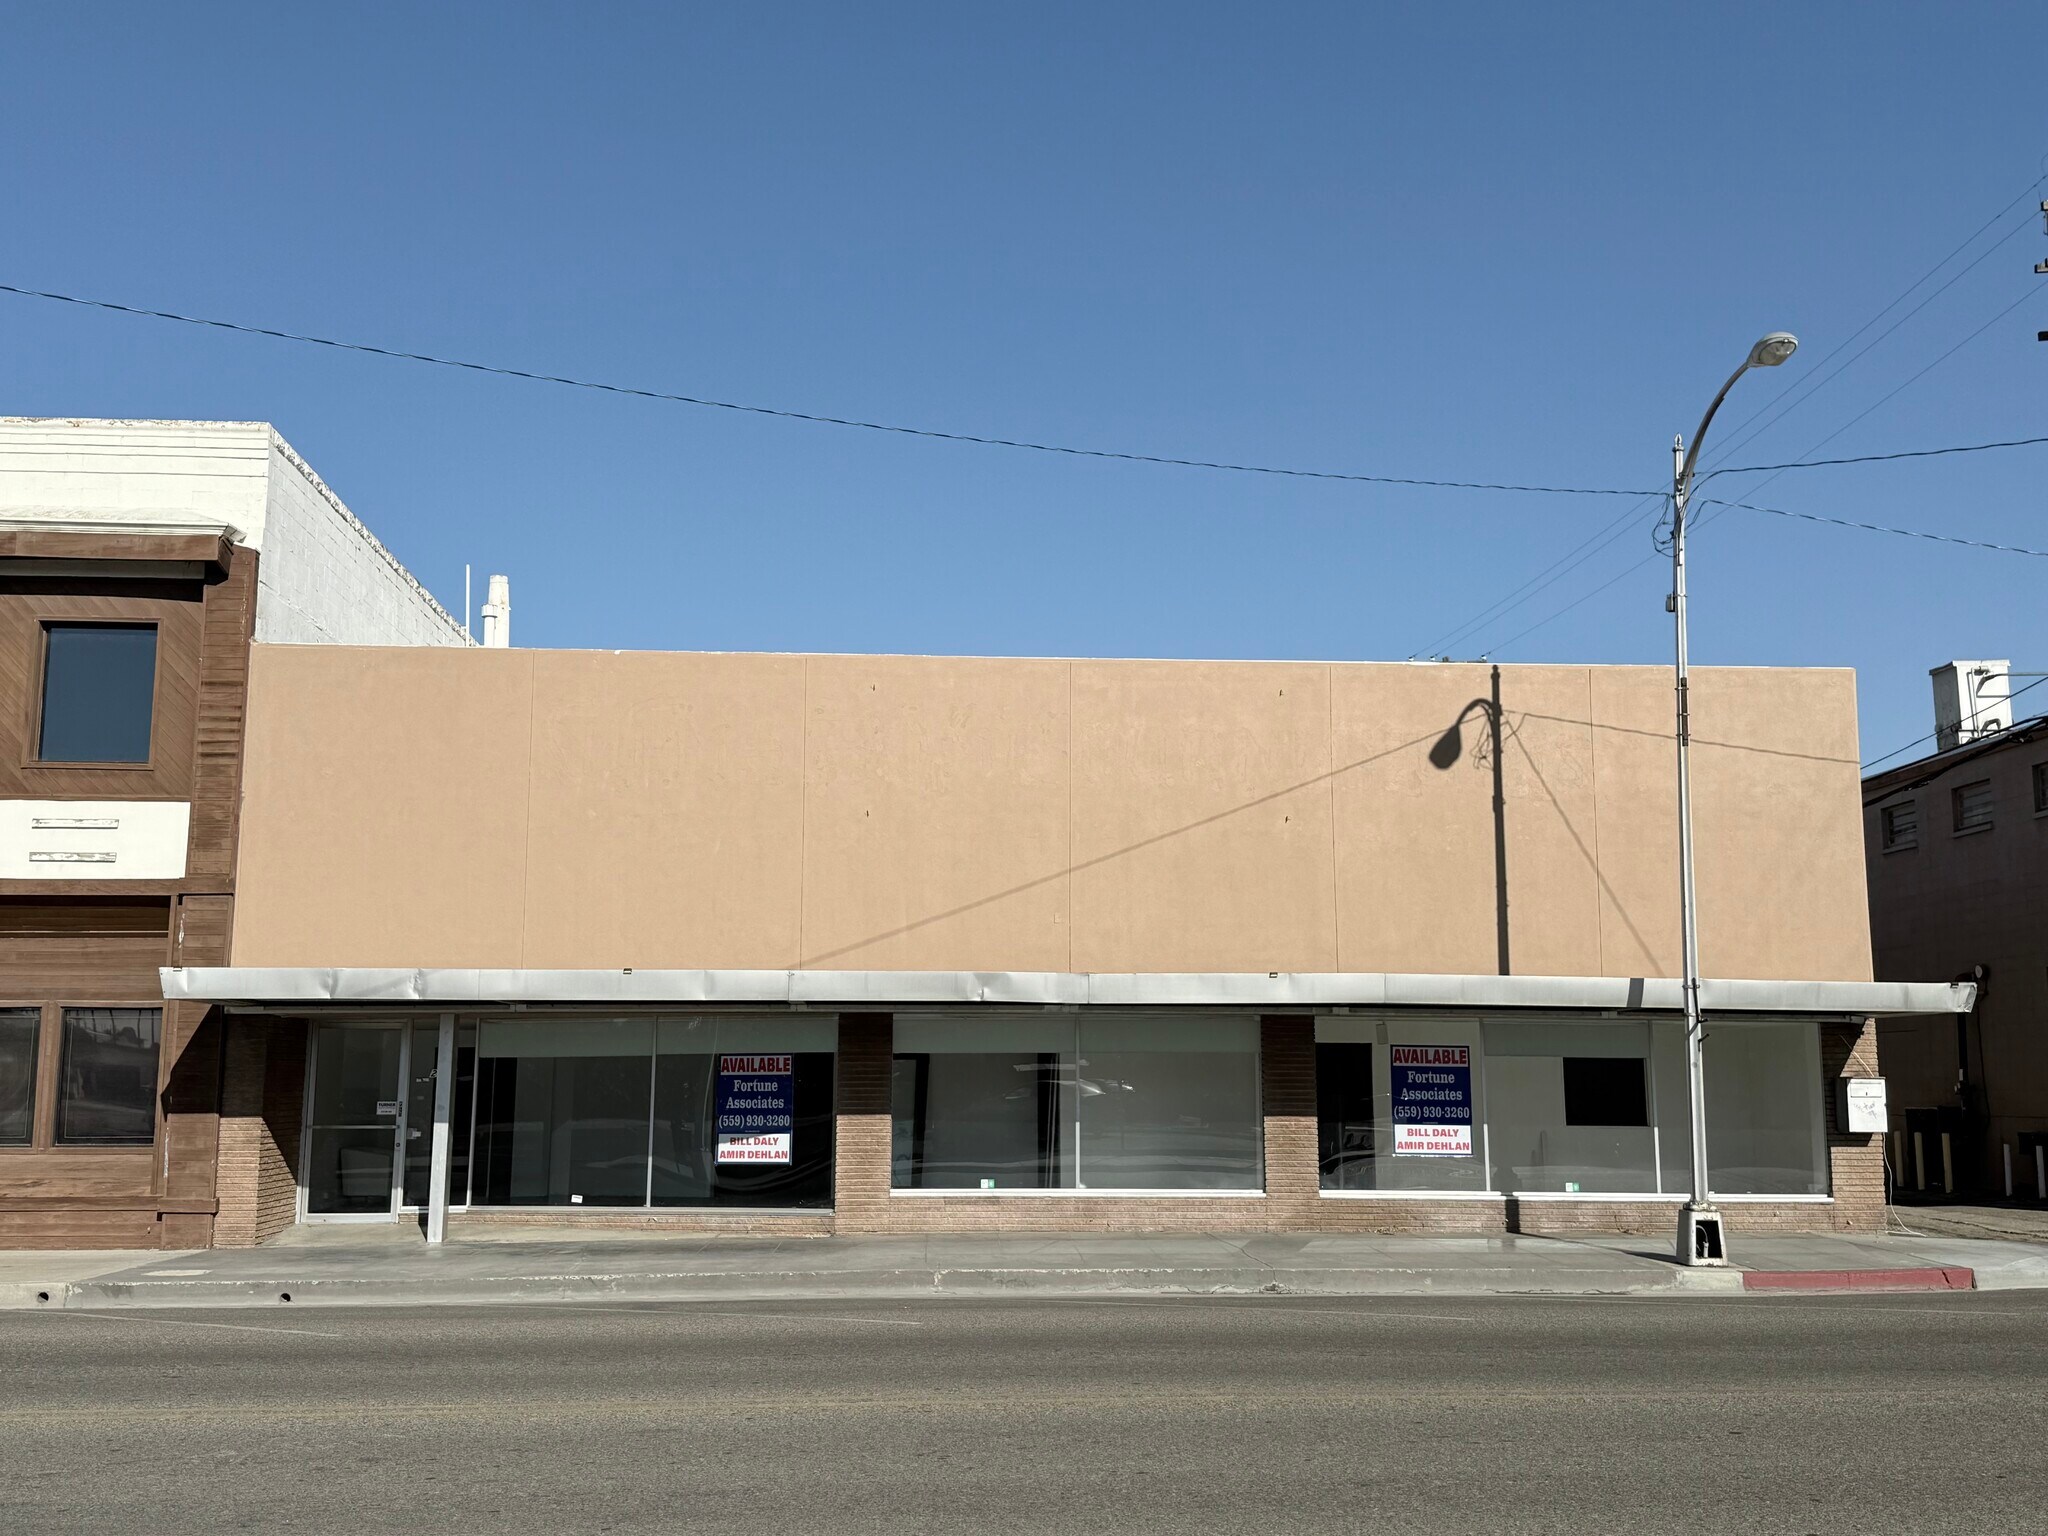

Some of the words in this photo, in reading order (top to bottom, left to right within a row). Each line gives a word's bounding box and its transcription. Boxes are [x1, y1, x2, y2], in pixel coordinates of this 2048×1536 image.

[1394, 1048, 1467, 1064] AVAILABLE
[721, 1057, 791, 1073] AVAILABLE
[1407, 1070, 1455, 1083] Fortune
[733, 1079, 778, 1092] Fortune
[1400, 1087, 1463, 1101] Associates
[726, 1095, 784, 1109] Associates
[1394, 1105, 1421, 1120] (559)
[1423, 1106, 1470, 1118] 930-3260
[719, 1115, 745, 1129] (559)
[746, 1115, 790, 1127] 930-3260
[1407, 1128, 1431, 1137] BILL
[1432, 1128, 1459, 1137] DALY
[729, 1137, 752, 1146] BILL
[753, 1137, 779, 1146] DALY
[1397, 1141, 1425, 1150] AMIR
[1426, 1141, 1470, 1150] DEHLAN
[719, 1150, 746, 1159] AMIR
[747, 1150, 788, 1159] DEHLAN
